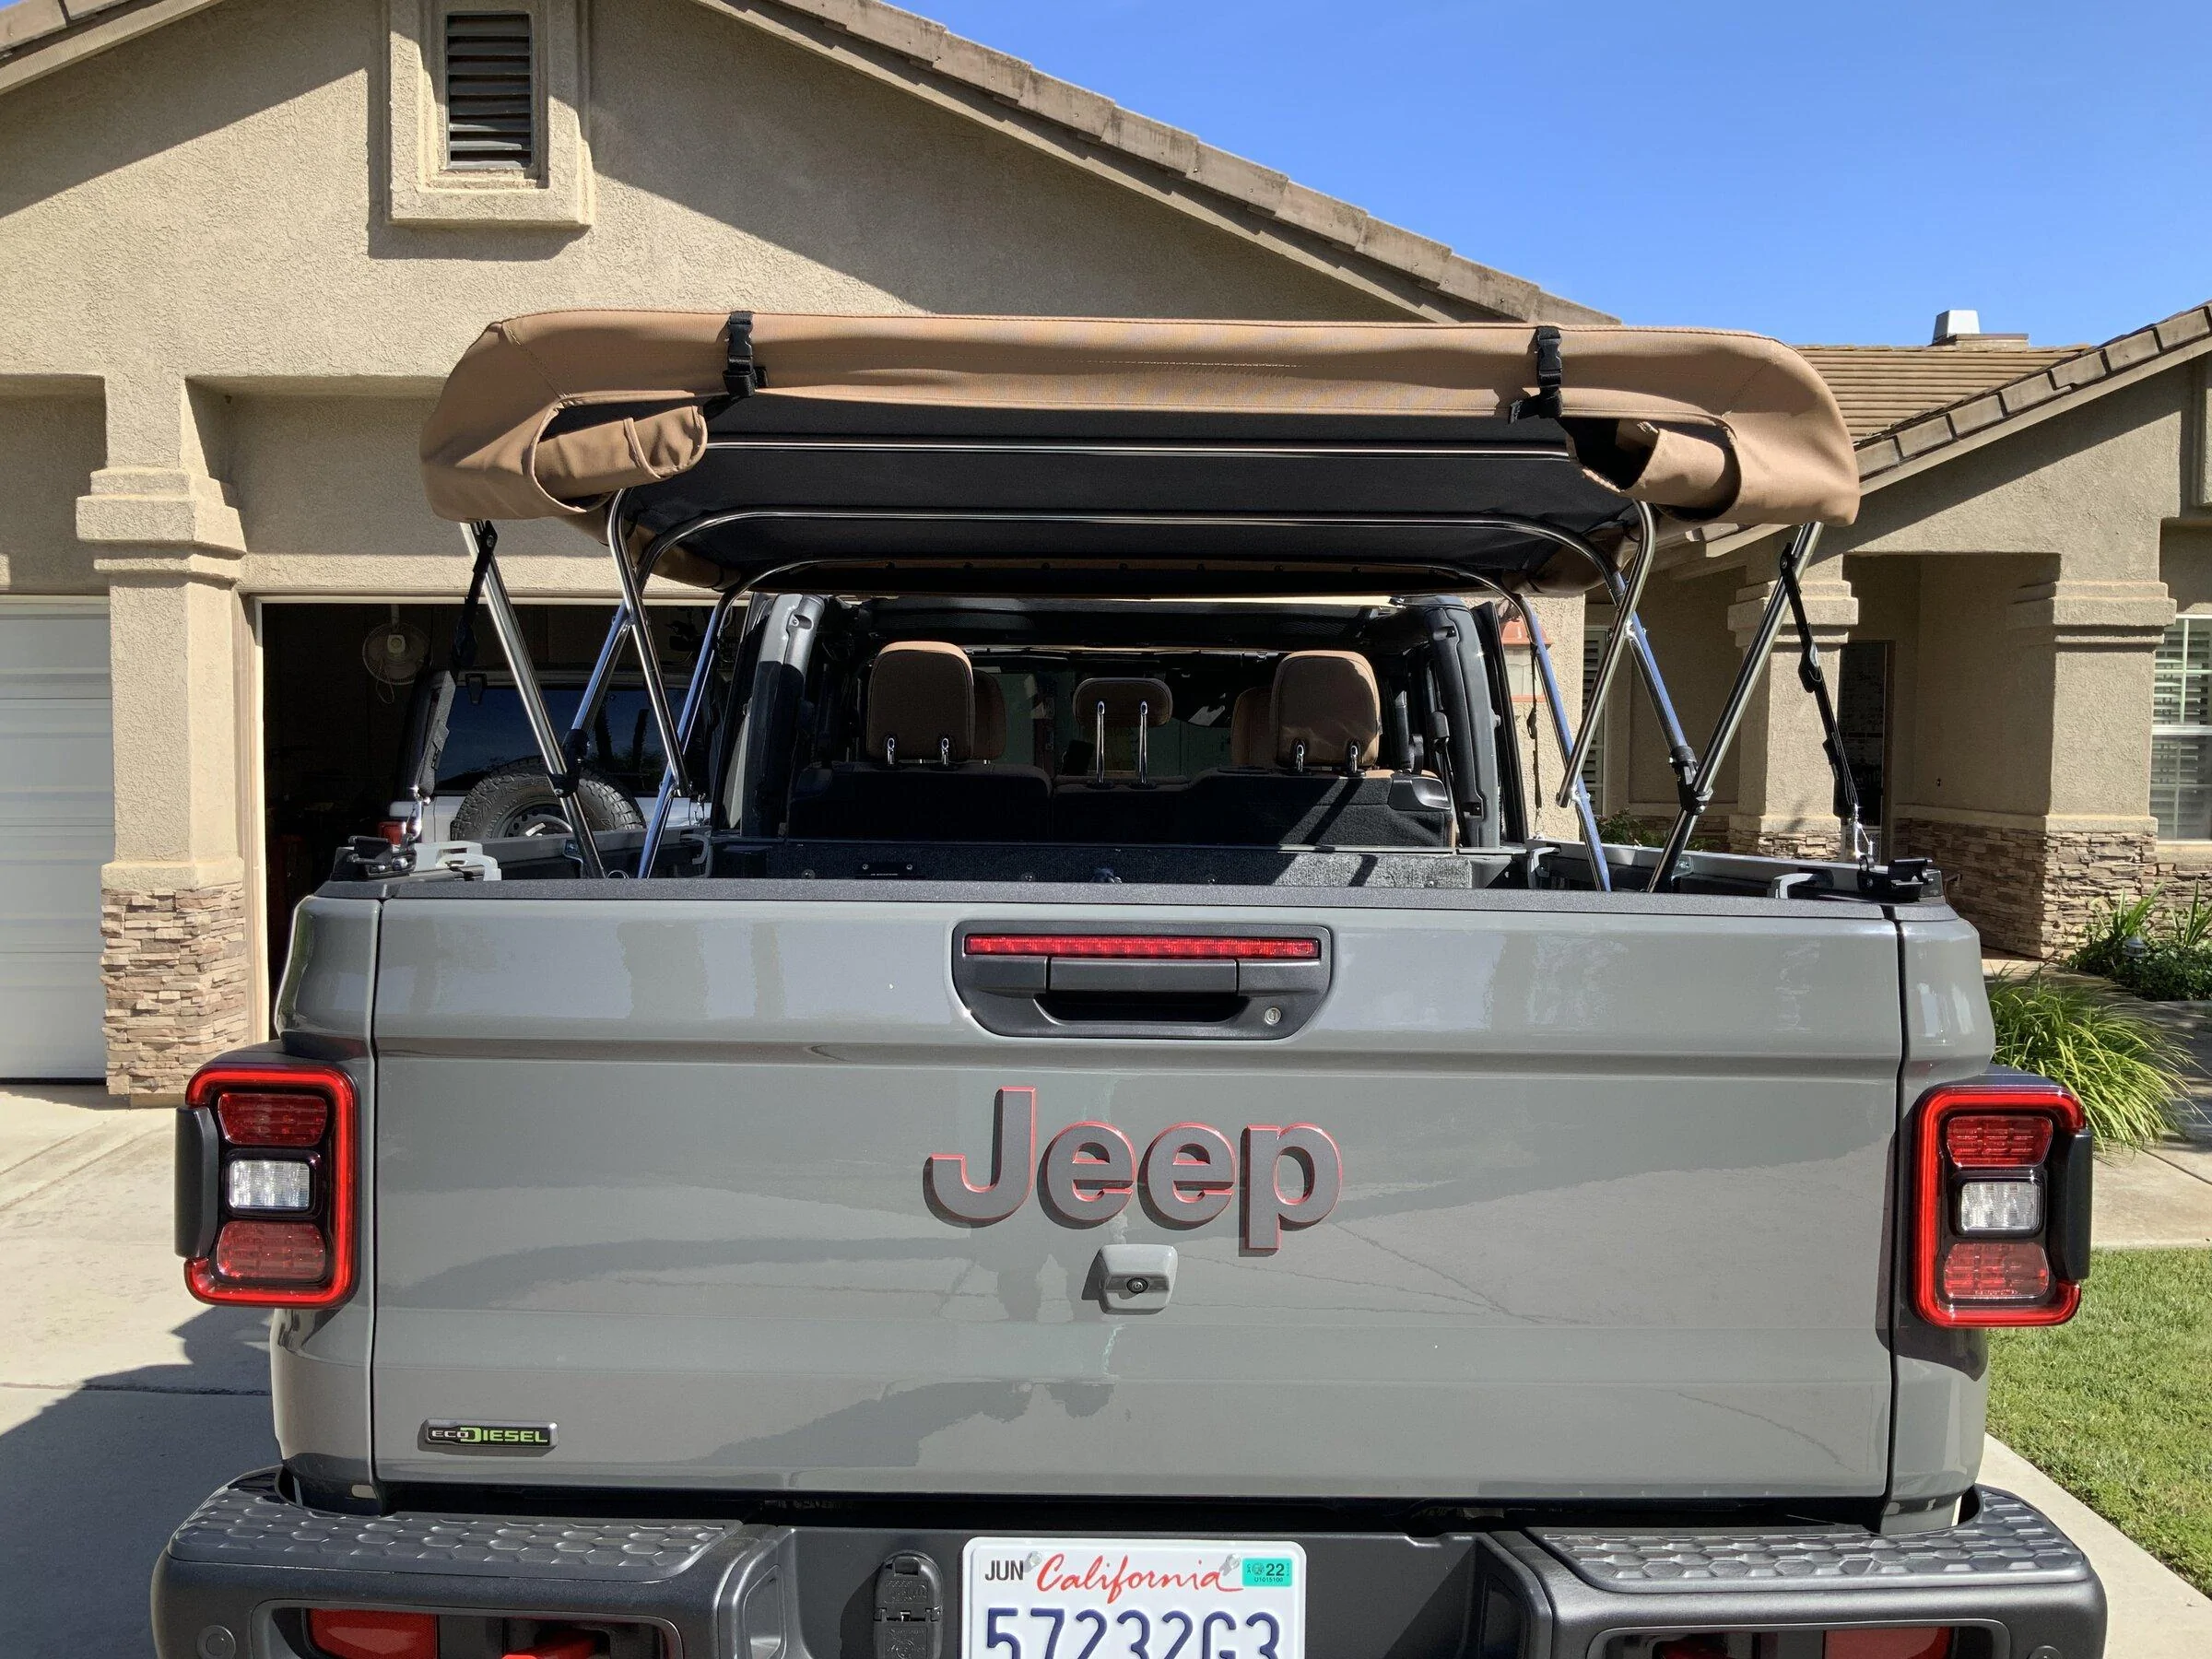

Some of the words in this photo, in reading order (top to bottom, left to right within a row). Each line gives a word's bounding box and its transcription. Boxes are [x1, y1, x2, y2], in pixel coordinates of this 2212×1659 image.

[927, 1086, 1343, 1251] Jeep
[984, 1559, 1024, 1581] JUN
[1036, 1553, 1244, 1604] California
[1265, 1562, 1285, 1576] 22
[987, 1606, 1281, 1659] 57232G3
